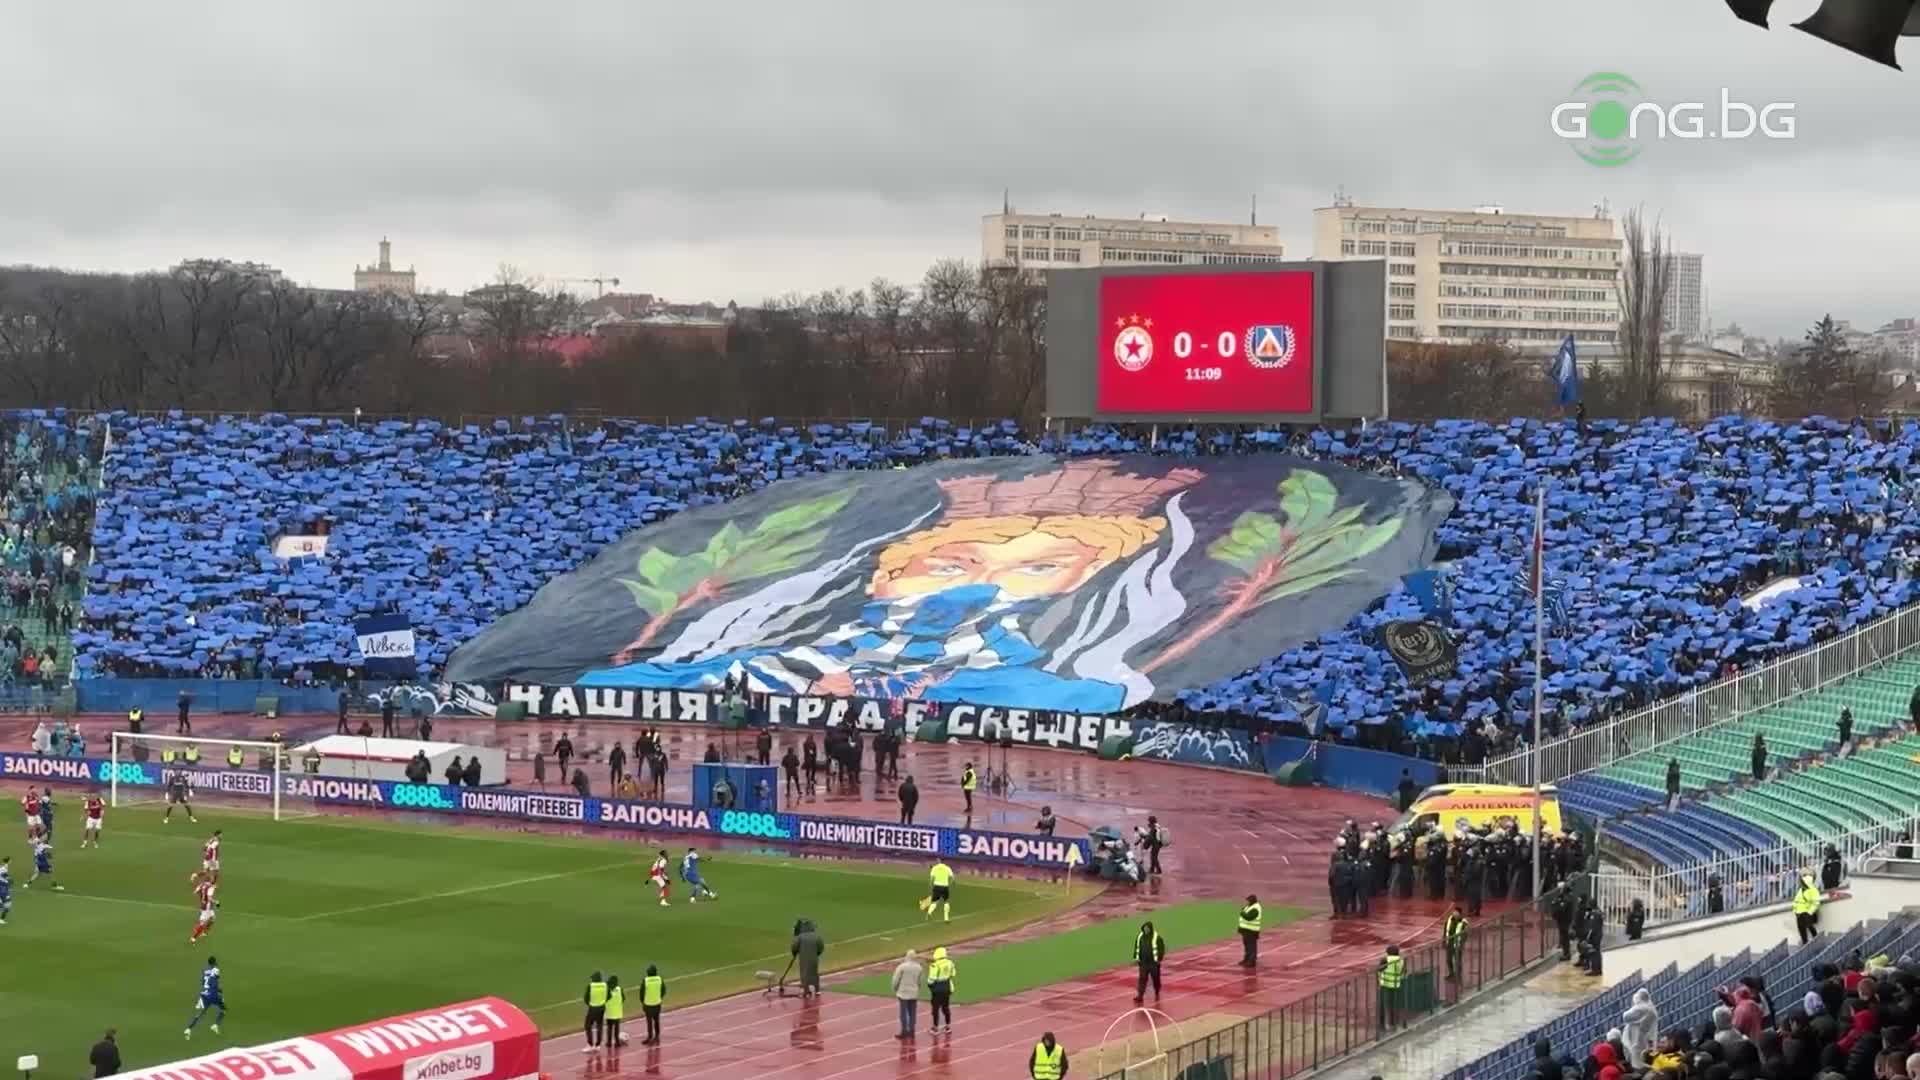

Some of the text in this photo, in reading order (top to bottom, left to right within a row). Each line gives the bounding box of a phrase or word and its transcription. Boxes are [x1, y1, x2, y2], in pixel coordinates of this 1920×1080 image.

[1174, 332, 1192, 357] 0
[1217, 331, 1236, 357] 0
[1185, 368, 1222, 380] 11:09
[4, 756, 91, 779] ЗАПОЧНА
[221, 772, 270, 793] FREEBET
[285, 778, 384, 802] ЗАПОЧНА
[462, 792, 582, 817] ГОЛЕМИЯТ FREEBET
[601, 803, 711, 830] ЗАПОЧНА
[800, 821, 936, 850] ГОЛЕМИЯТ FREEBET
[957, 834, 1085, 865] ЗАПОЧНА
[332, 1004, 508, 1058] WINBET
[416, 1055, 482, 1079] winbet.bg
